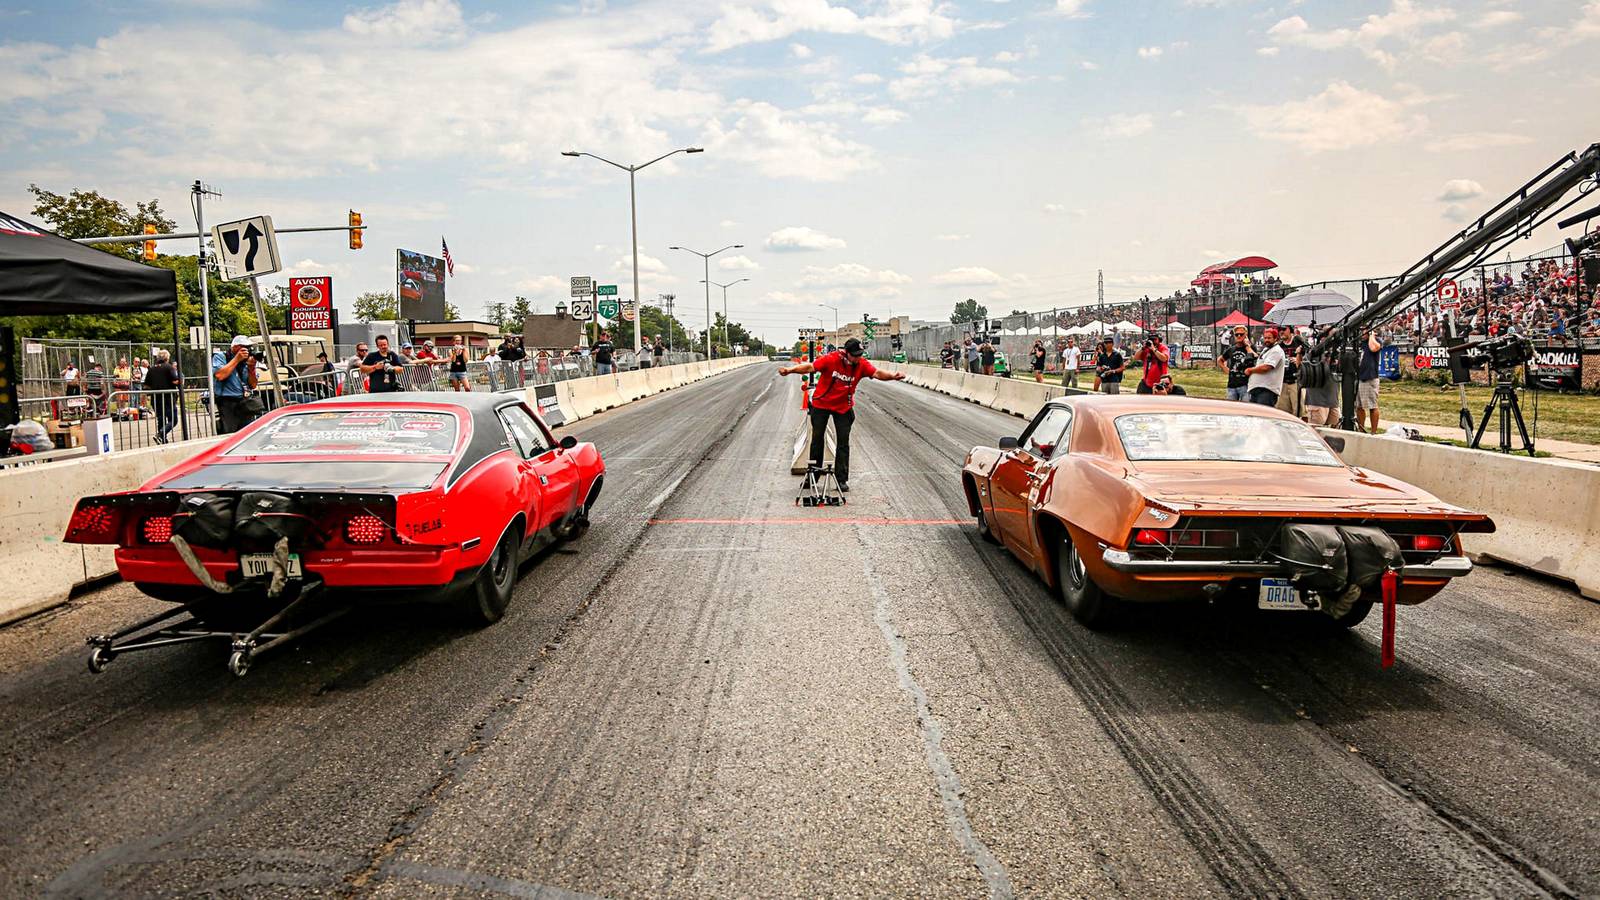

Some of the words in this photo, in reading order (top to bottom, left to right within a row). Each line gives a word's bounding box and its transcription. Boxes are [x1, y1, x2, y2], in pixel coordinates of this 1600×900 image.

[599, 287, 616, 295] SOUTH
[574, 305, 590, 316] 24
[601, 305, 615, 316] 75
[292, 311, 330, 320] DONUTS
[294, 320, 328, 329] COFFEE
[1184, 345, 1212, 353] OVERDRIVE
[1430, 358, 1449, 367] GEAR
[247, 560, 268, 574] YOU
[1267, 587, 1295, 603] DRAG
